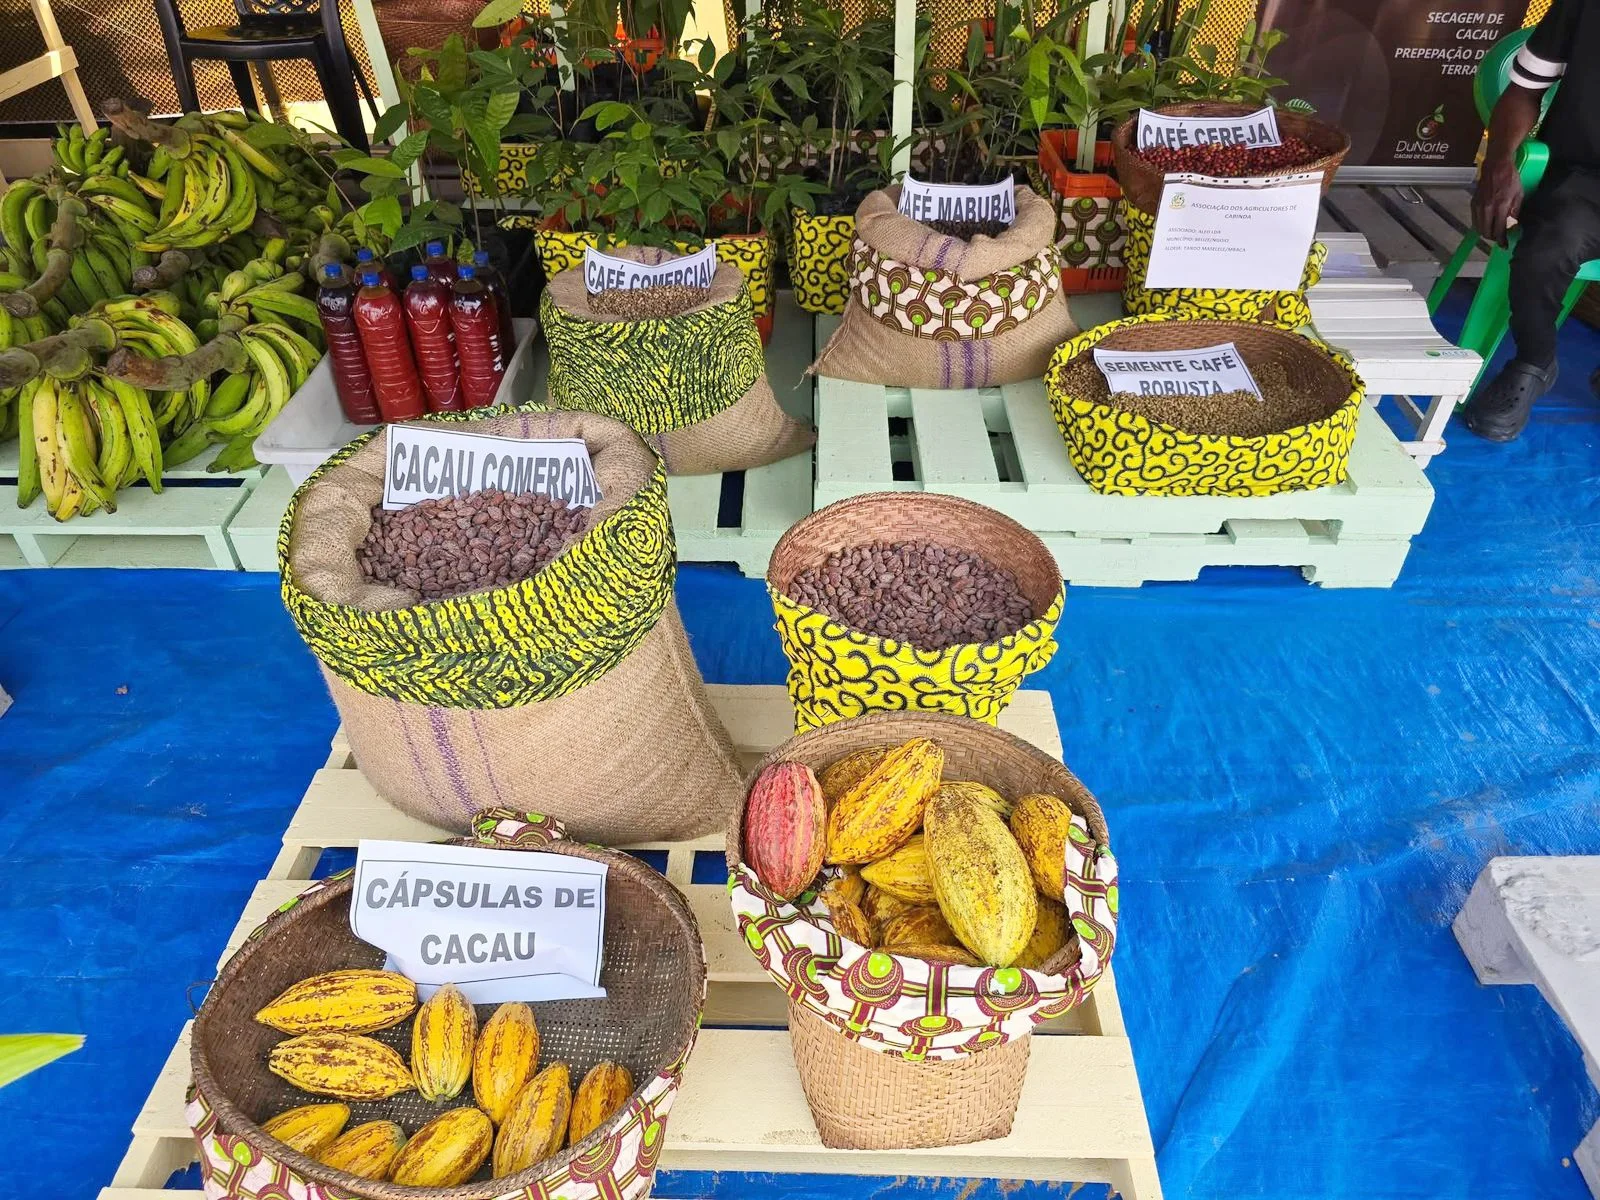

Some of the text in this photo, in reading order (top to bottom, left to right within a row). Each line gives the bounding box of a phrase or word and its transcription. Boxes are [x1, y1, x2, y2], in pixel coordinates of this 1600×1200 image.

[1426, 12, 1505, 25] SECAGEM DE
[1455, 28, 1499, 41] CACAU
[1394, 46, 1489, 62] PREPEPAÇÃO D
[1441, 64, 1478, 76] TERRA
[1142, 122, 1273, 150] CAFÉ CEREJA
[1395, 140, 1450, 153] DuNorte
[938, 189, 1012, 222] MABUBA
[1191, 202, 1229, 212] ASSOCIAÇÃO
[587, 258, 712, 290] CAFÉ COMERCIAL
[1104, 352, 1237, 373] SEMENTE CAFÉ
[1139, 380, 1224, 397] ROBUSTA
[392, 442, 604, 505] CACAU COMERCIAL
[365, 870, 596, 910] CÁPSULAS DE
[420, 931, 536, 966] CACAU
